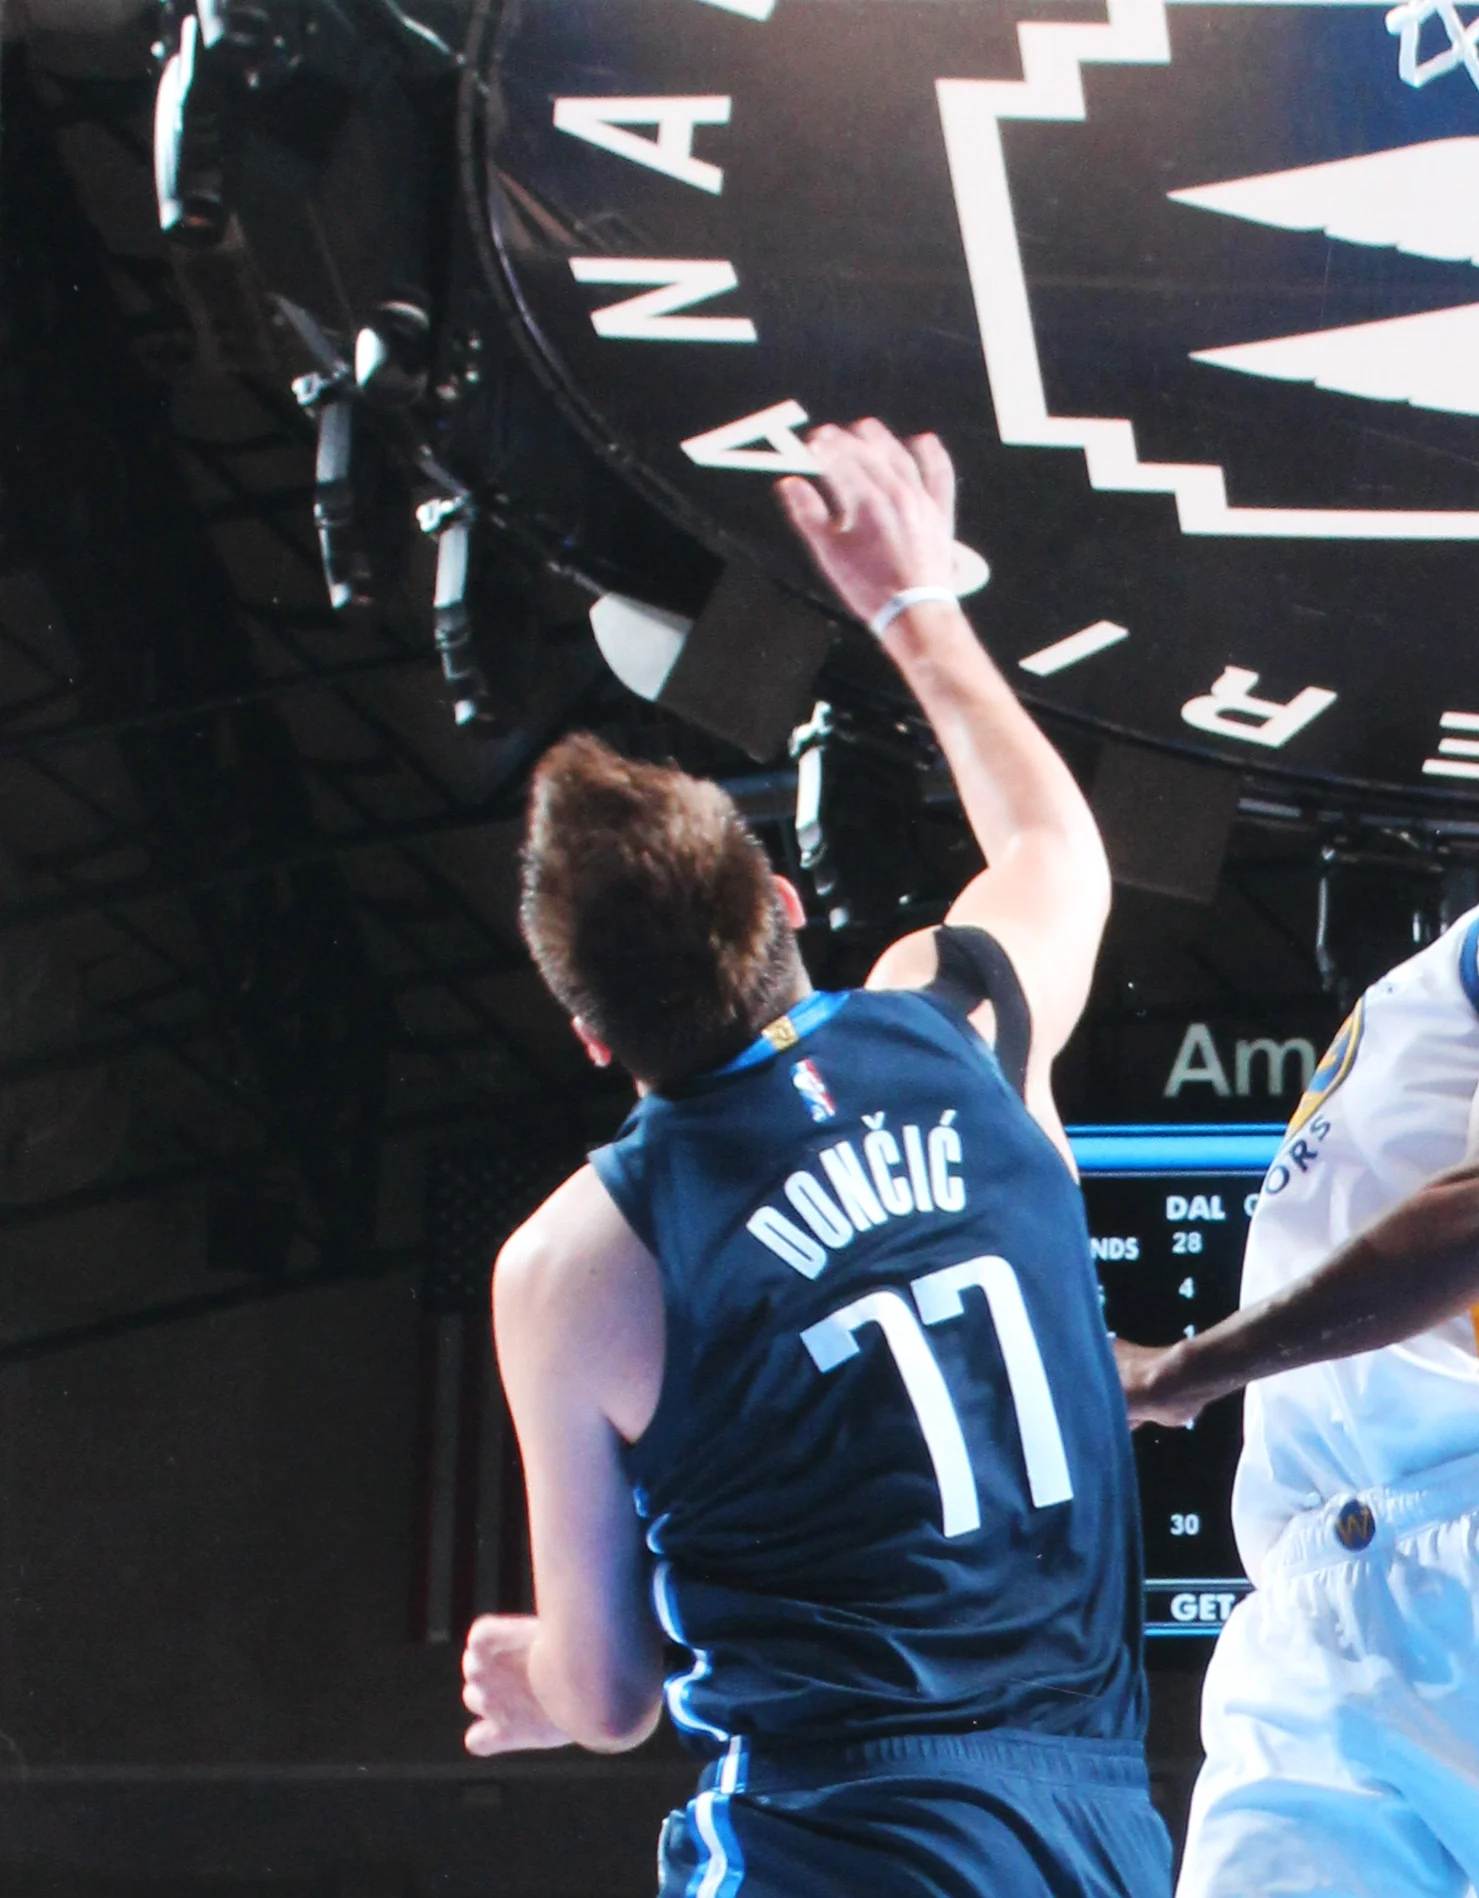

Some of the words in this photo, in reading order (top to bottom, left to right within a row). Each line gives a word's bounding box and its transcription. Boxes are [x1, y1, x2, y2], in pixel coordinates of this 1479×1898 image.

[746, 1110, 966, 1281] DONČIĆ
[1165, 1195, 1226, 1221] DAL
[1171, 1231, 1203, 1254] 28
[1178, 1276, 1195, 1299] 4
[801, 1255, 1073, 1538] 77
[1169, 1513, 1200, 1536] 30
[1170, 1593, 1237, 1622] GET
